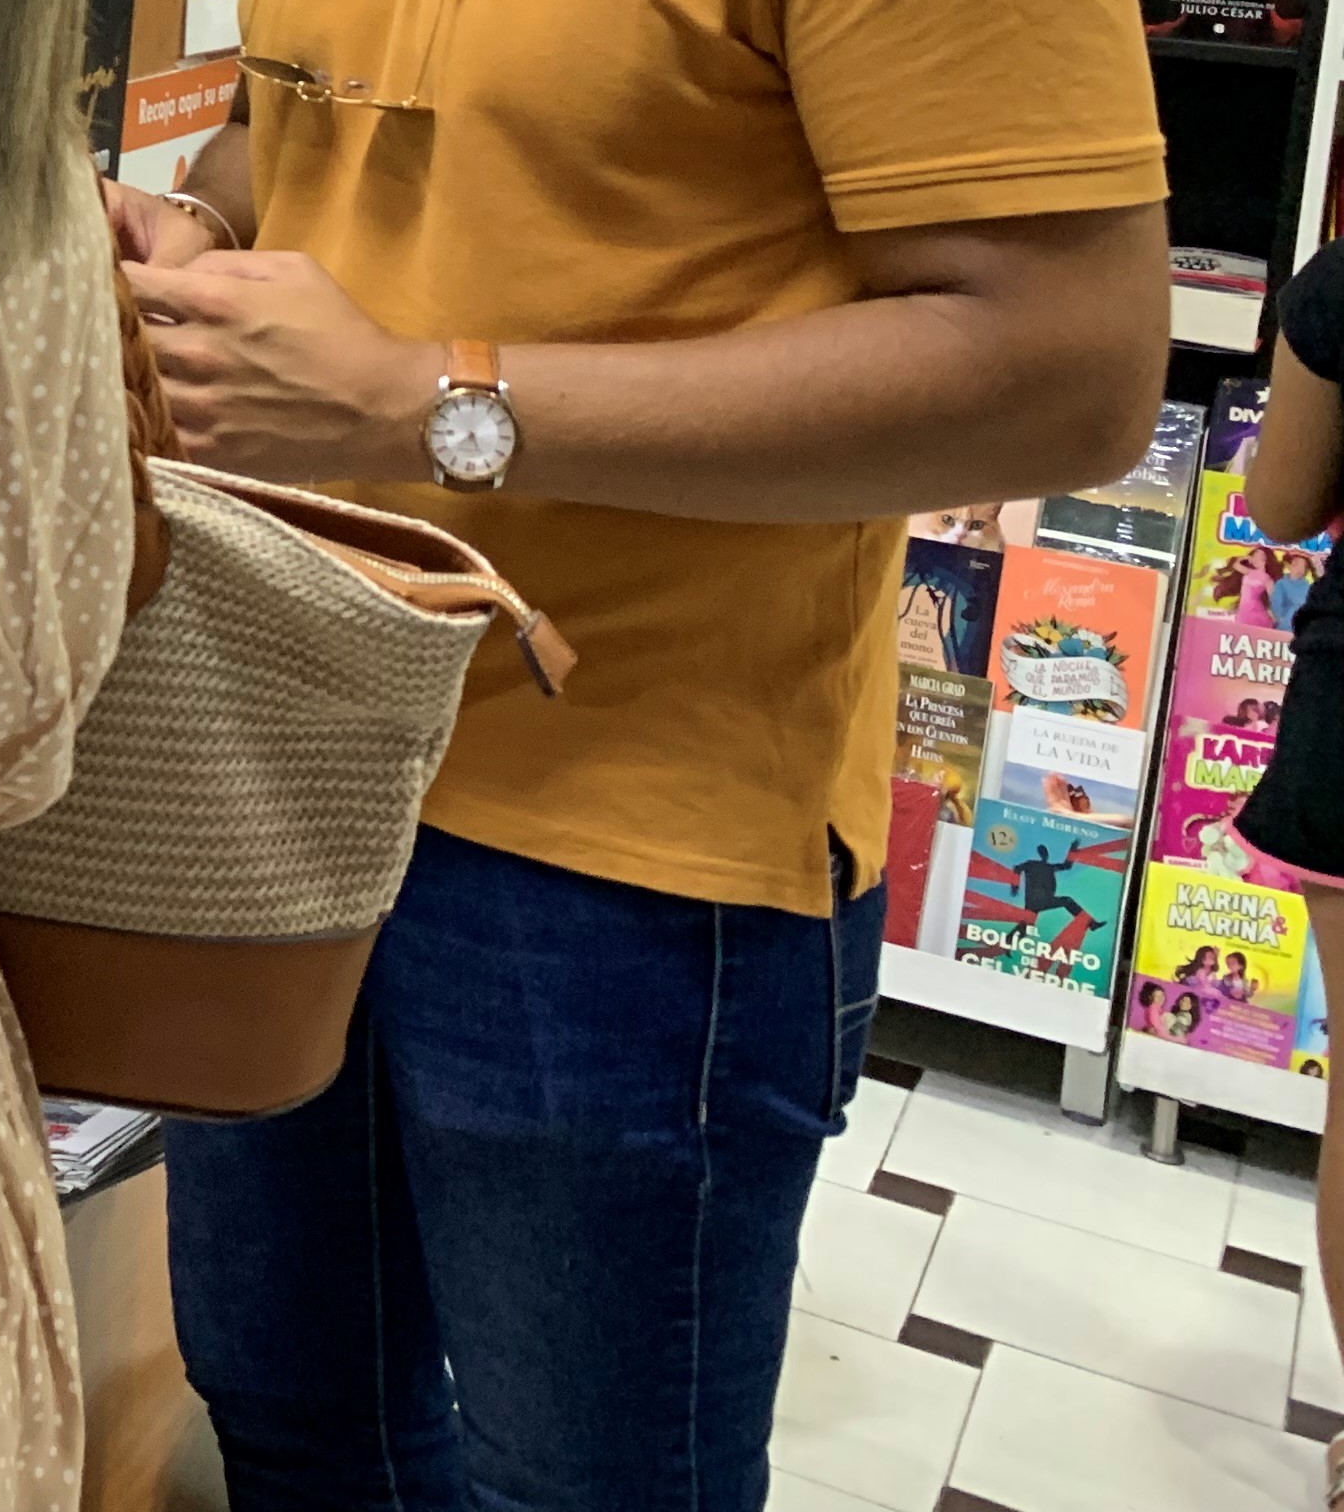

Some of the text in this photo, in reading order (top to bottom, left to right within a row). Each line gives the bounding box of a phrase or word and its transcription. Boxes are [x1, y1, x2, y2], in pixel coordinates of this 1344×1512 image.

[1179, 2, 1264, 21] JULIO CÉSAR
[915, 604, 930, 618] La
[903, 616, 938, 631] cueva
[909, 627, 928, 642] del
[900, 640, 934, 655] mono
[1034, 663, 1047, 674] LA
[909, 675, 966, 697] MARCIA GRAD
[1025, 672, 1046, 685] QUE
[1052, 683, 1091, 696] MUNDO
[909, 711, 929, 725] QUE
[907, 723, 925, 736] LOS
[922, 737, 935, 749] DE
[1032, 726, 1119, 755] LA RUEDA DE
[1036, 742, 1111, 771] LA VIDA
[1176, 882, 1289, 937] KARINA &
[1026, 925, 1040, 937] EL
[1168, 904, 1281, 948] MARINA
[966, 923, 1101, 971] BOLÍGRAFO
[1021, 955, 1038, 968] DE
